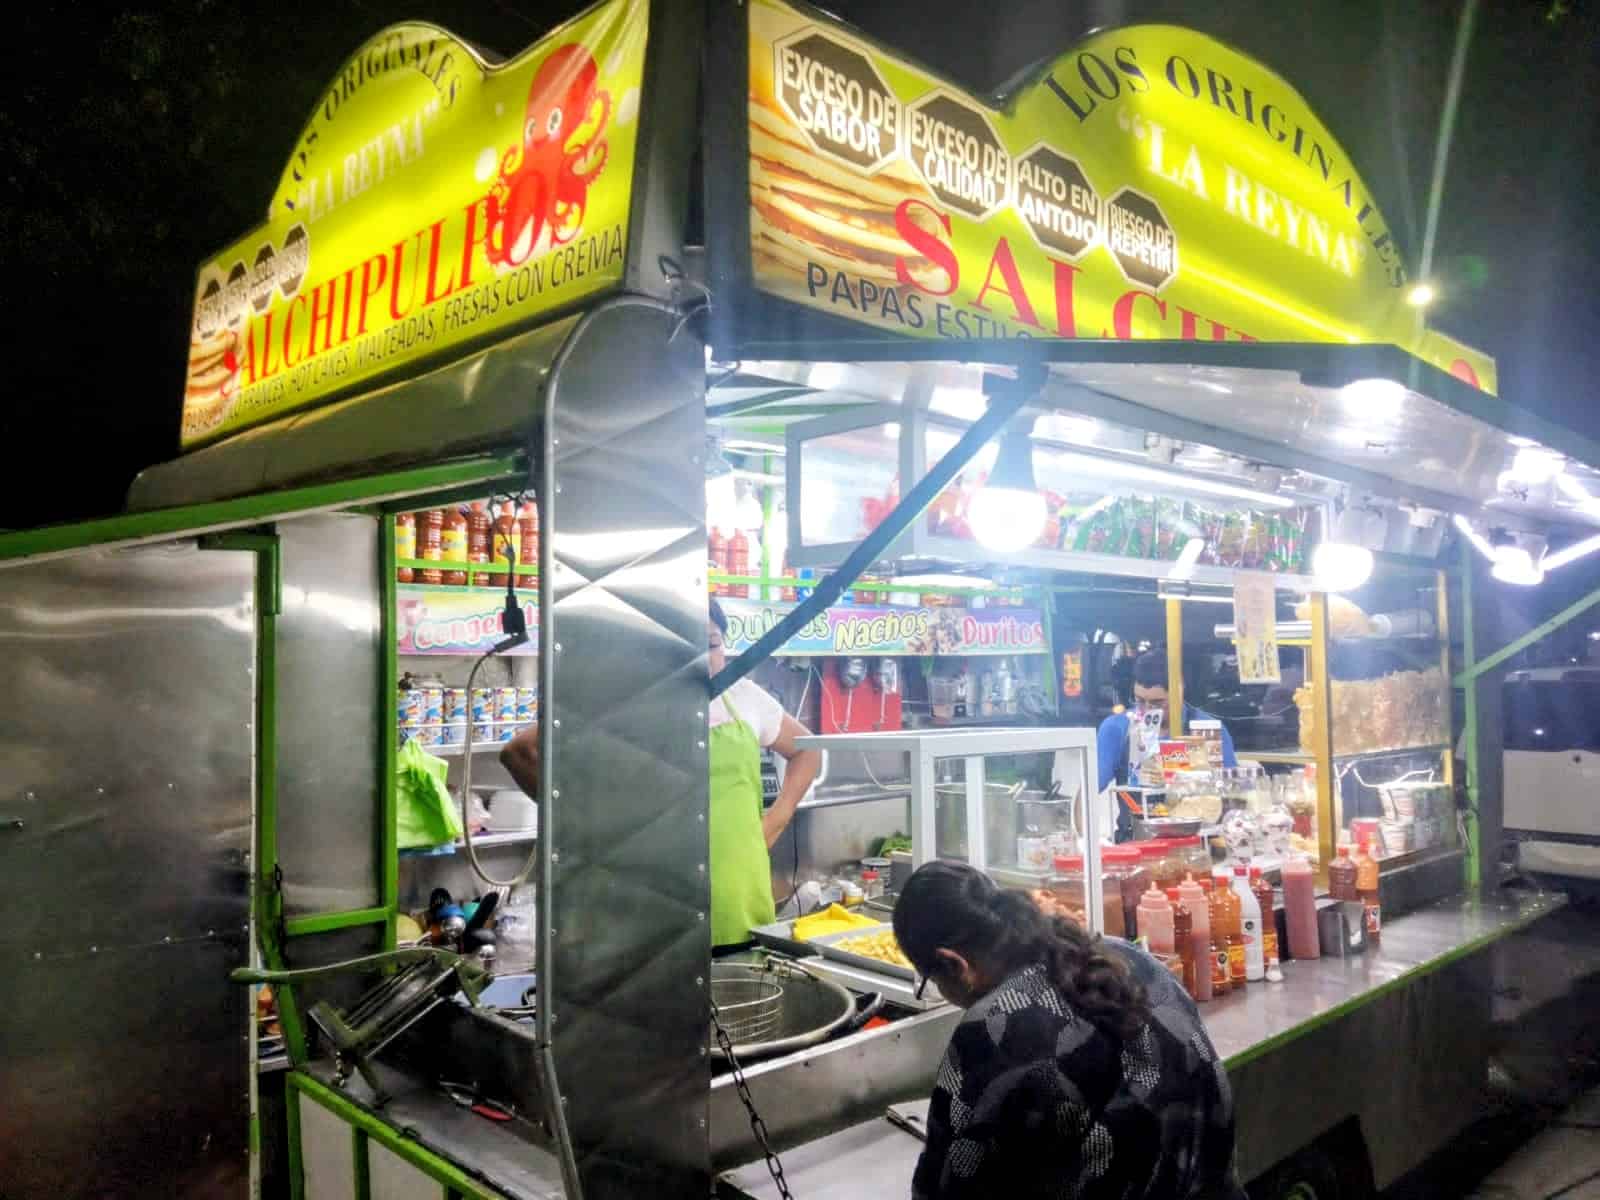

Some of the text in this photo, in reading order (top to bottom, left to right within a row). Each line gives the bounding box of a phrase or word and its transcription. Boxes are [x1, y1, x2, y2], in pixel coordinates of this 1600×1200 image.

[782, 49, 895, 134] EXCESO DE
[800, 94, 882, 162] SABOR
[911, 110, 1006, 185] EXCESO DE
[924, 150, 997, 210] CALIDAD
[1019, 160, 1096, 217] ALTO EN
[1043, 47, 1405, 288] LOS ORIGINALES
[1022, 192, 1097, 245] ANTOJO
[1111, 203, 1173, 249] RIESGO DE
[1111, 224, 1172, 274] REPETIR
[443, 279, 500, 330] FRESAS
[506, 264, 544, 307] CON
[551, 224, 624, 288] CREMA
[806, 261, 924, 329] PAPAS
[835, 610, 929, 652] Nachos
[962, 615, 1044, 646] Duritos
